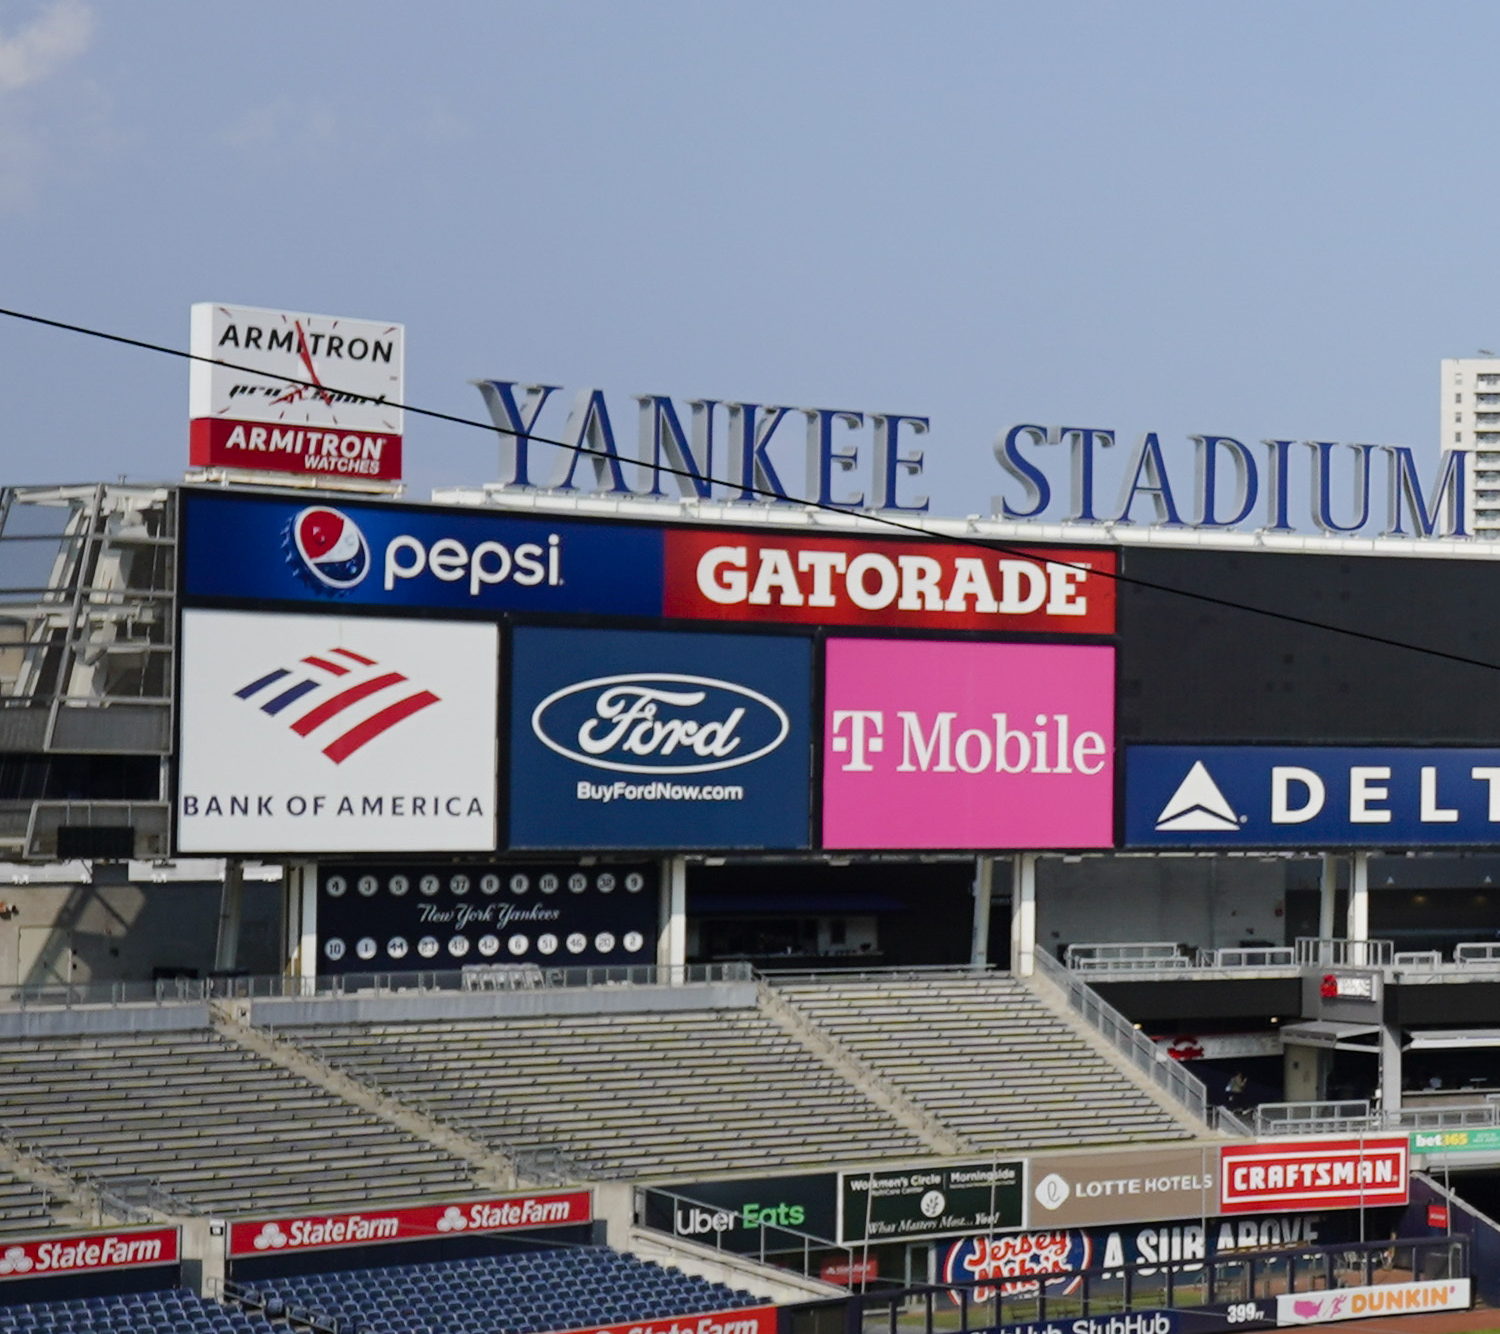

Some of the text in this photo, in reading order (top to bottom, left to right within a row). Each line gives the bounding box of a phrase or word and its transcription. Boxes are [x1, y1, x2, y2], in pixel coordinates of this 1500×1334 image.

[218, 324, 393, 363] ARMITRON
[226, 425, 384, 460] ARMITRON
[470, 378, 1470, 539] YANKEE STADIUM
[304, 454, 380, 475] WATCHES
[384, 534, 562, 595] pepsi
[697, 545, 1088, 616] GATORADE
[578, 685, 744, 758] Ford
[897, 711, 1105, 775] Mobile
[183, 795, 485, 818] BANK OF AMERICA
[576, 781, 744, 803] BuyFordNow.com
[418, 903, 561, 931] New York Yankees
[1416, 1133, 1468, 1147] bet365
[910, 1173, 942, 1186] Circle
[1075, 1174, 1213, 1199] LOTTE HOTELS
[1233, 1159, 1393, 1192] CRAFTSMAN
[677, 1203, 805, 1236] Uber Eats
[965, 1228, 1071, 1269] Jersey
[1102, 1219, 1320, 1279] A SUB ABOVE
